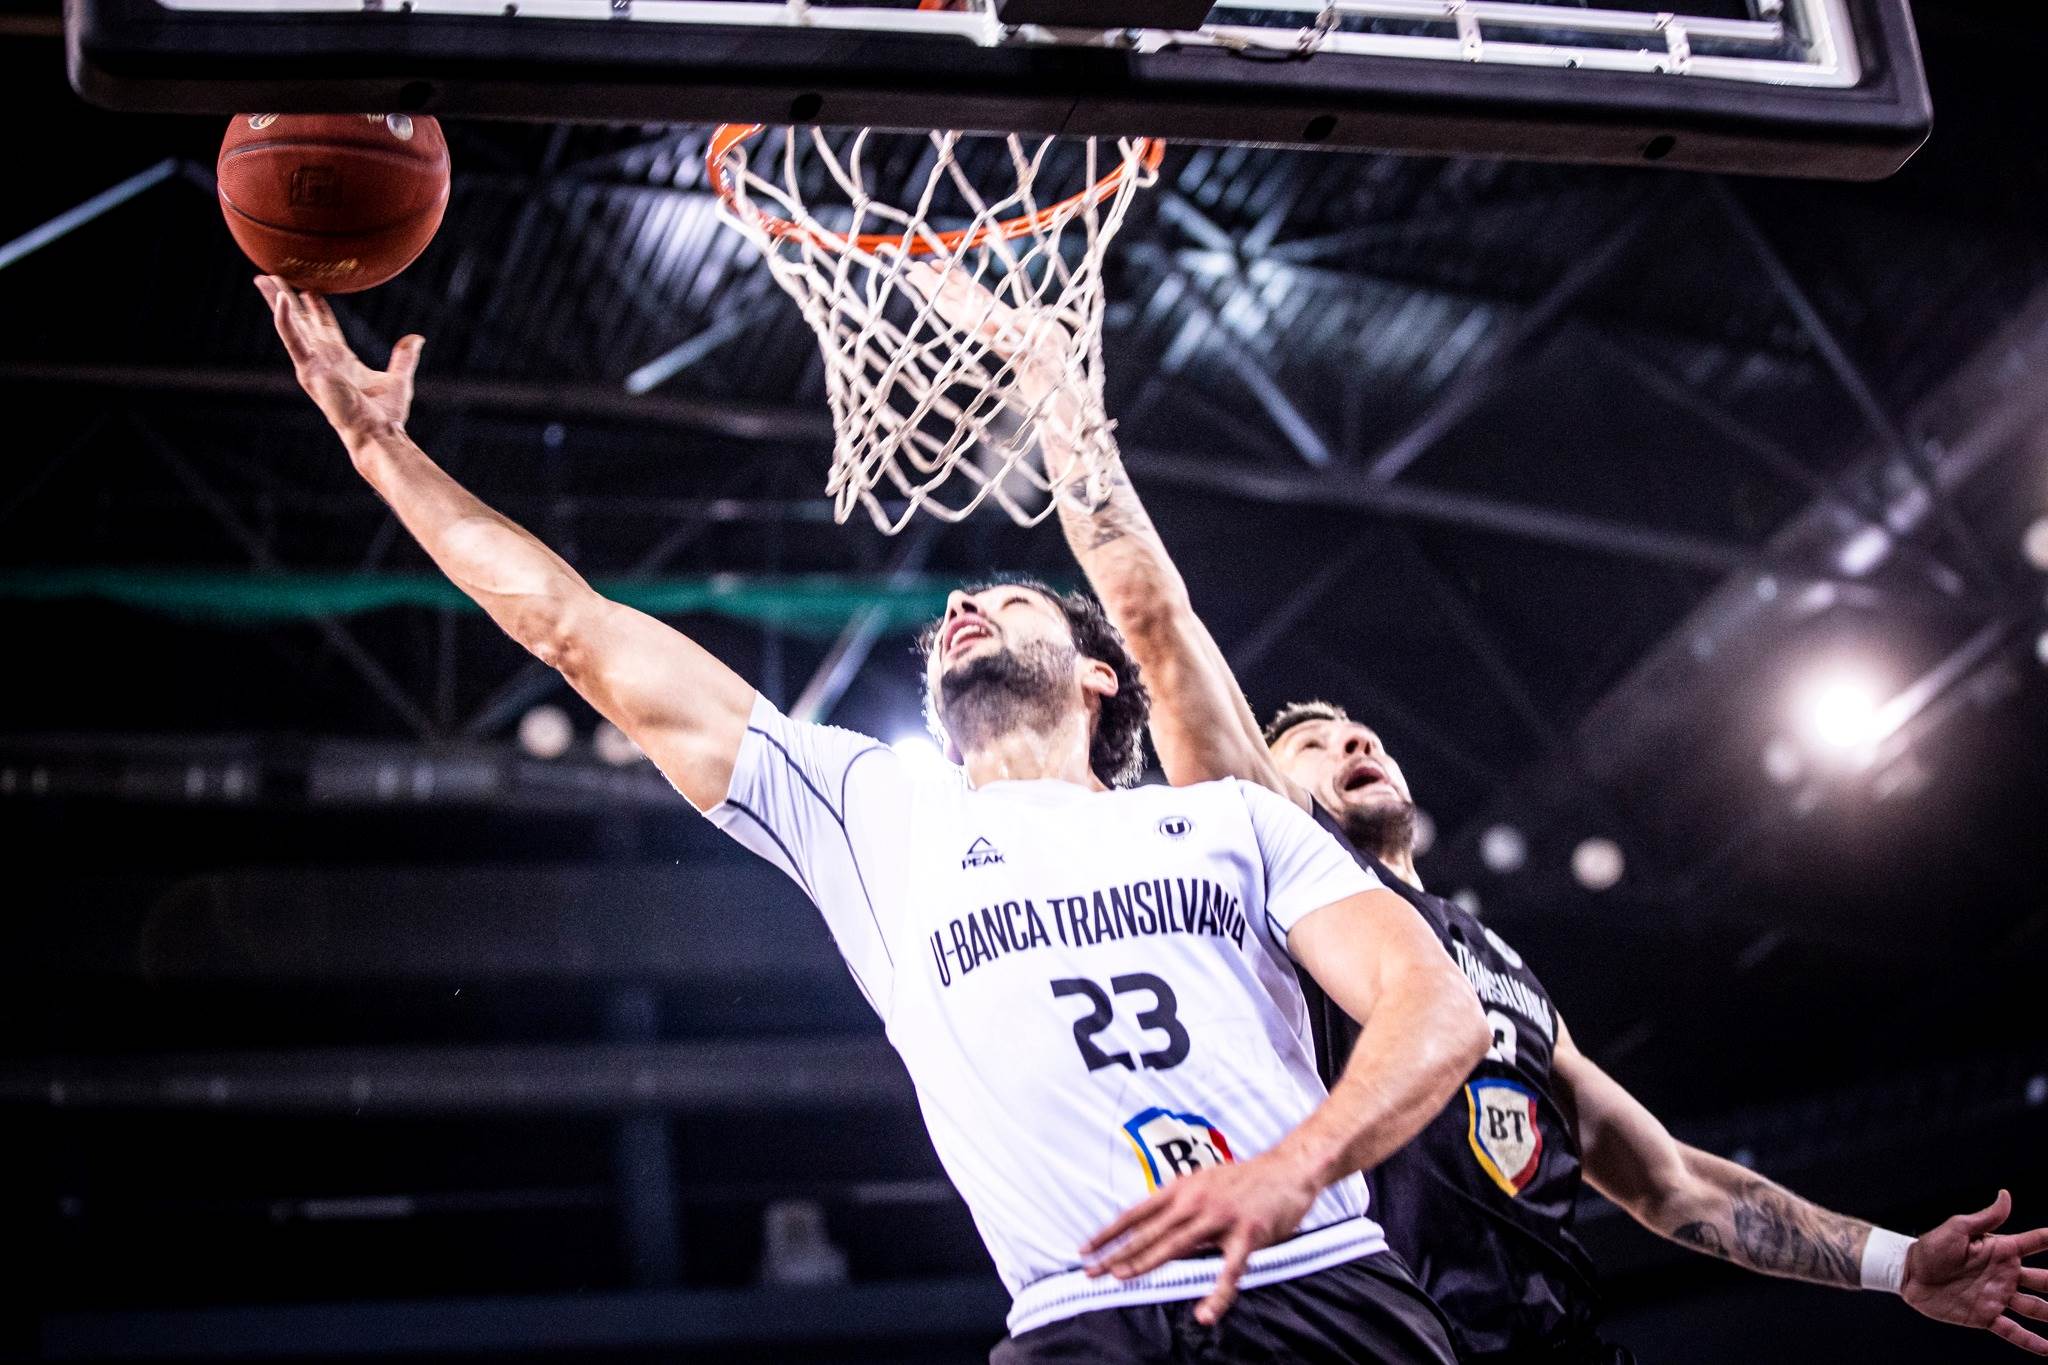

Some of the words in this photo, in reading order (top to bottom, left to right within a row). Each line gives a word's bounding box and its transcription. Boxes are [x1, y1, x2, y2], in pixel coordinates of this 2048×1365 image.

[962, 854, 1005, 870] PEAK
[930, 901, 1051, 987] U-BANCA
[1046, 878, 1245, 952] TRANSILVANIA
[1050, 972, 1190, 1072] 23
[1486, 1105, 1526, 1144] BT
[1155, 1136, 1222, 1178] B
